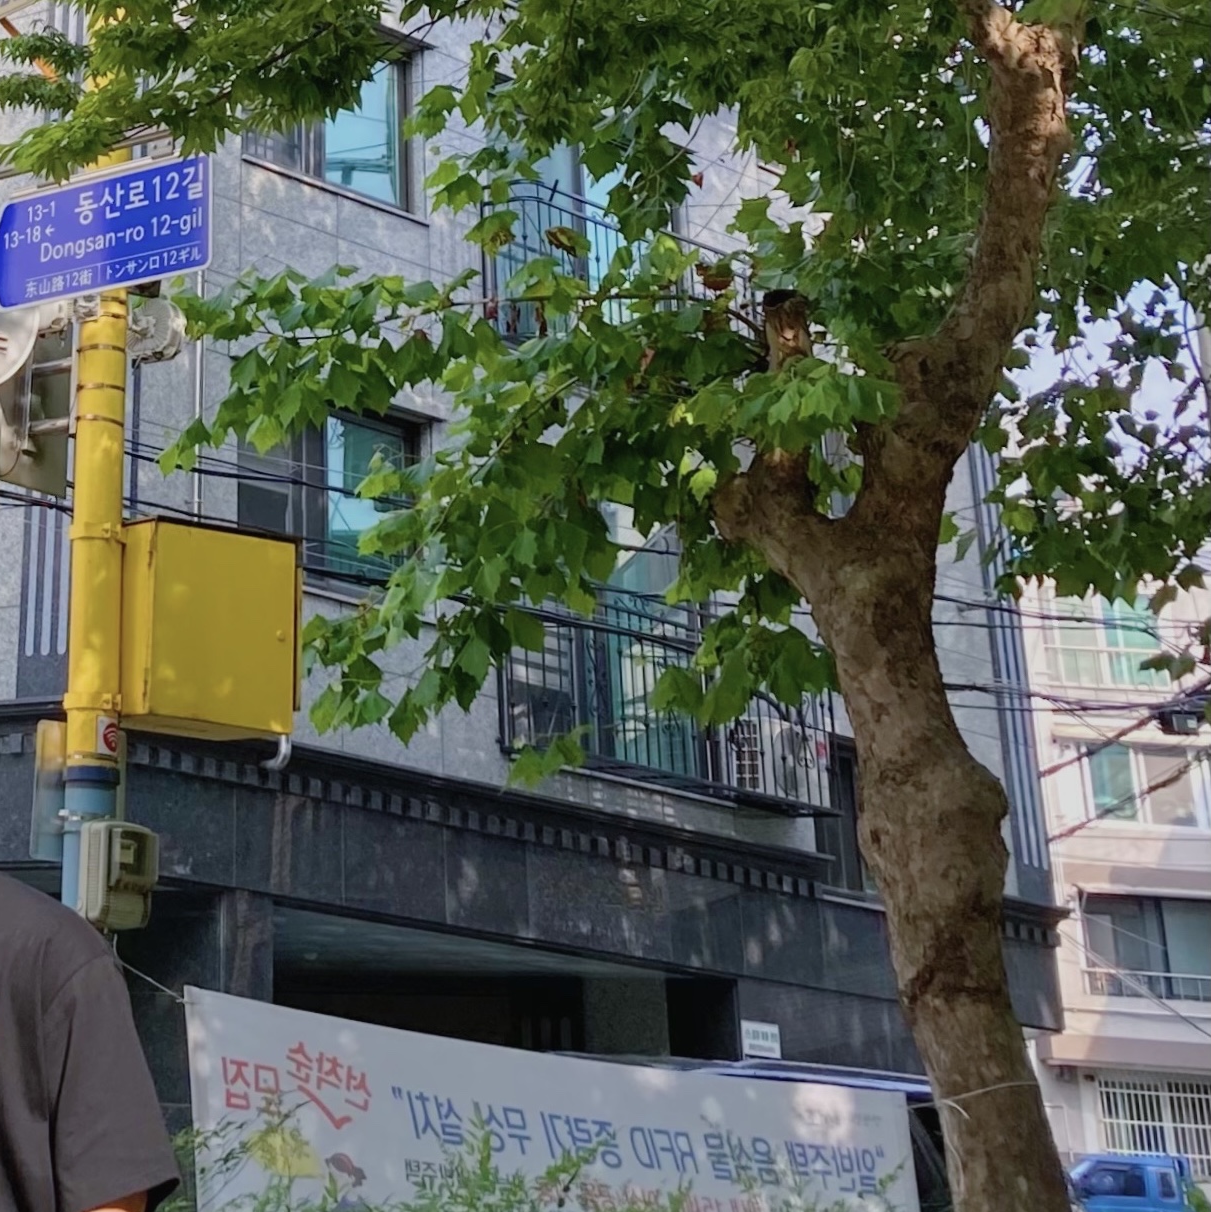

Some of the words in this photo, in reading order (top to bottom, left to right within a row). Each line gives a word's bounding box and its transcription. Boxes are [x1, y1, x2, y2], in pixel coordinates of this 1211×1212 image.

[27, 201, 56, 223] 13-1
[3, 225, 41, 249] 13-18
[40, 224, 144, 263] Dongsan-ro
[151, 207, 203, 238] 12-gil
